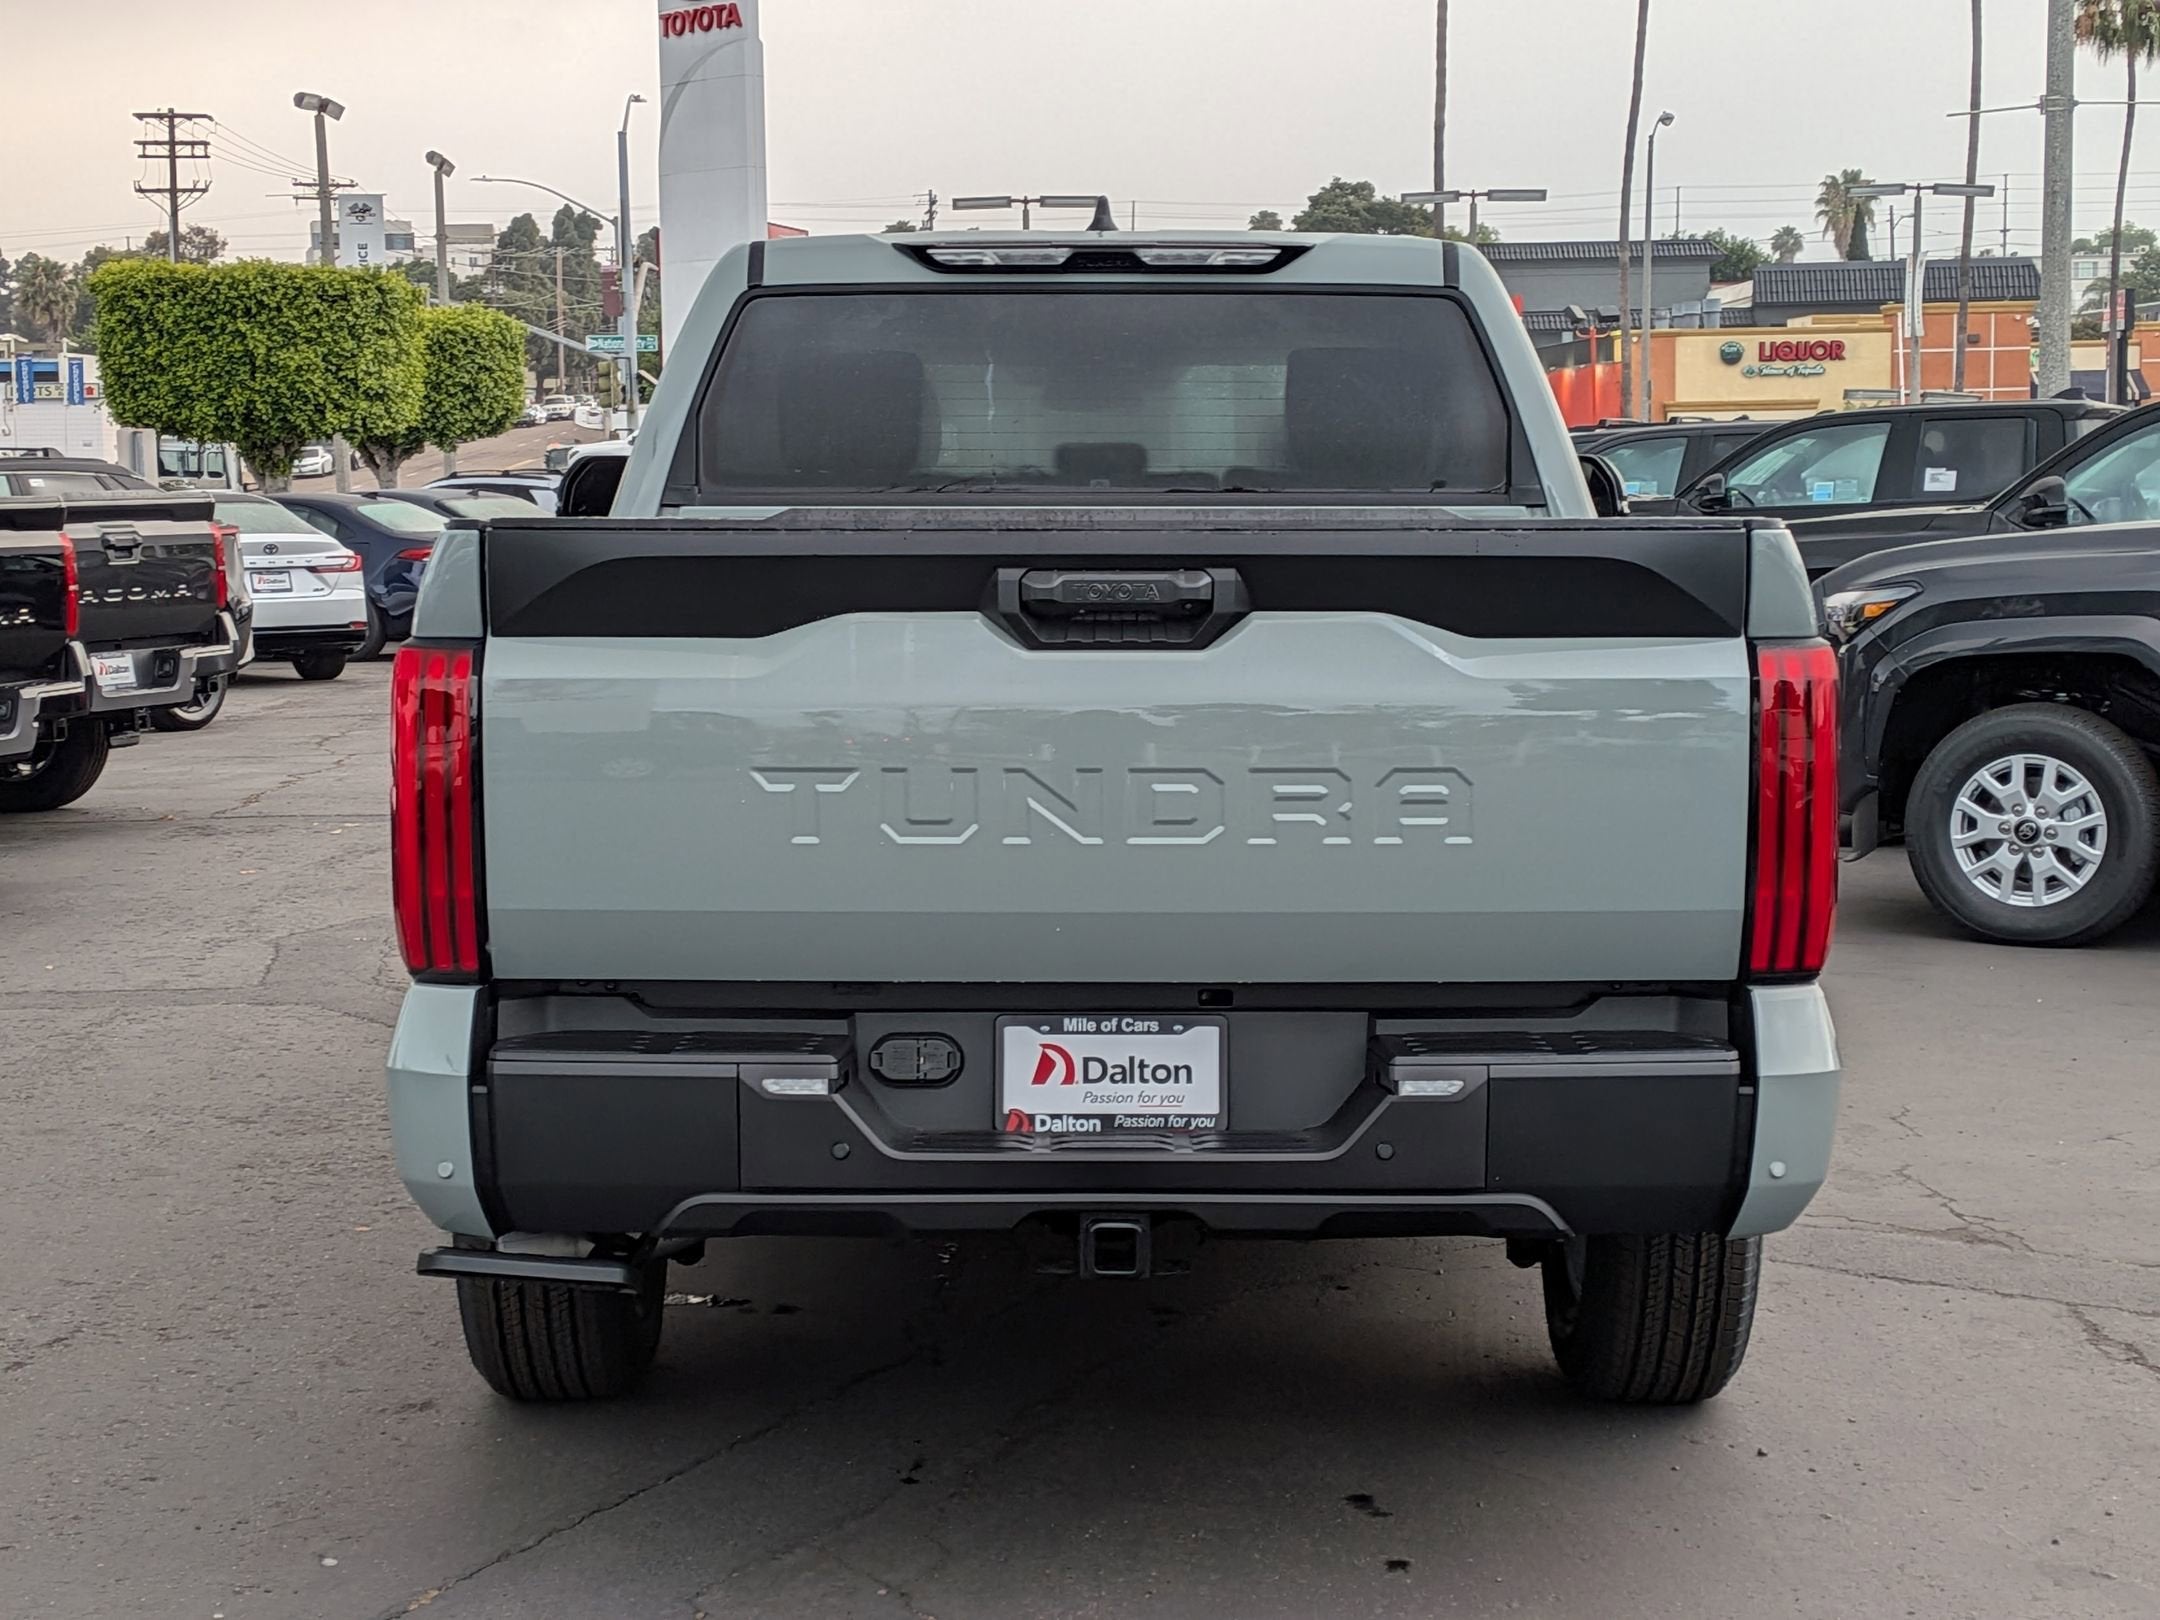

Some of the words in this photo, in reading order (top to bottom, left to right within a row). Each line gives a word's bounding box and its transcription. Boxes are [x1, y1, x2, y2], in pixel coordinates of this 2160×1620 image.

[659, 3, 743, 38] TOYOTA
[1758, 340, 1846, 362] LIQUOR
[78, 584, 192, 604] ACOMA
[1071, 583, 1160, 600] TOYOTA
[750, 766, 1473, 844] TUNDRA
[1063, 1018, 1096, 1032] Mile
[1100, 1018, 1117, 1032] of
[1121, 1019, 1159, 1032] Cars
[1082, 1056, 1193, 1085] Dalton
[1082, 1091, 1133, 1104] Passion
[1137, 1091, 1156, 1104] for
[1159, 1094, 1185, 1106] you
[1035, 1115, 1101, 1132] Dalton
[1114, 1115, 1164, 1128] Passion
[1167, 1115, 1187, 1128] for
[1189, 1117, 1216, 1130] you
